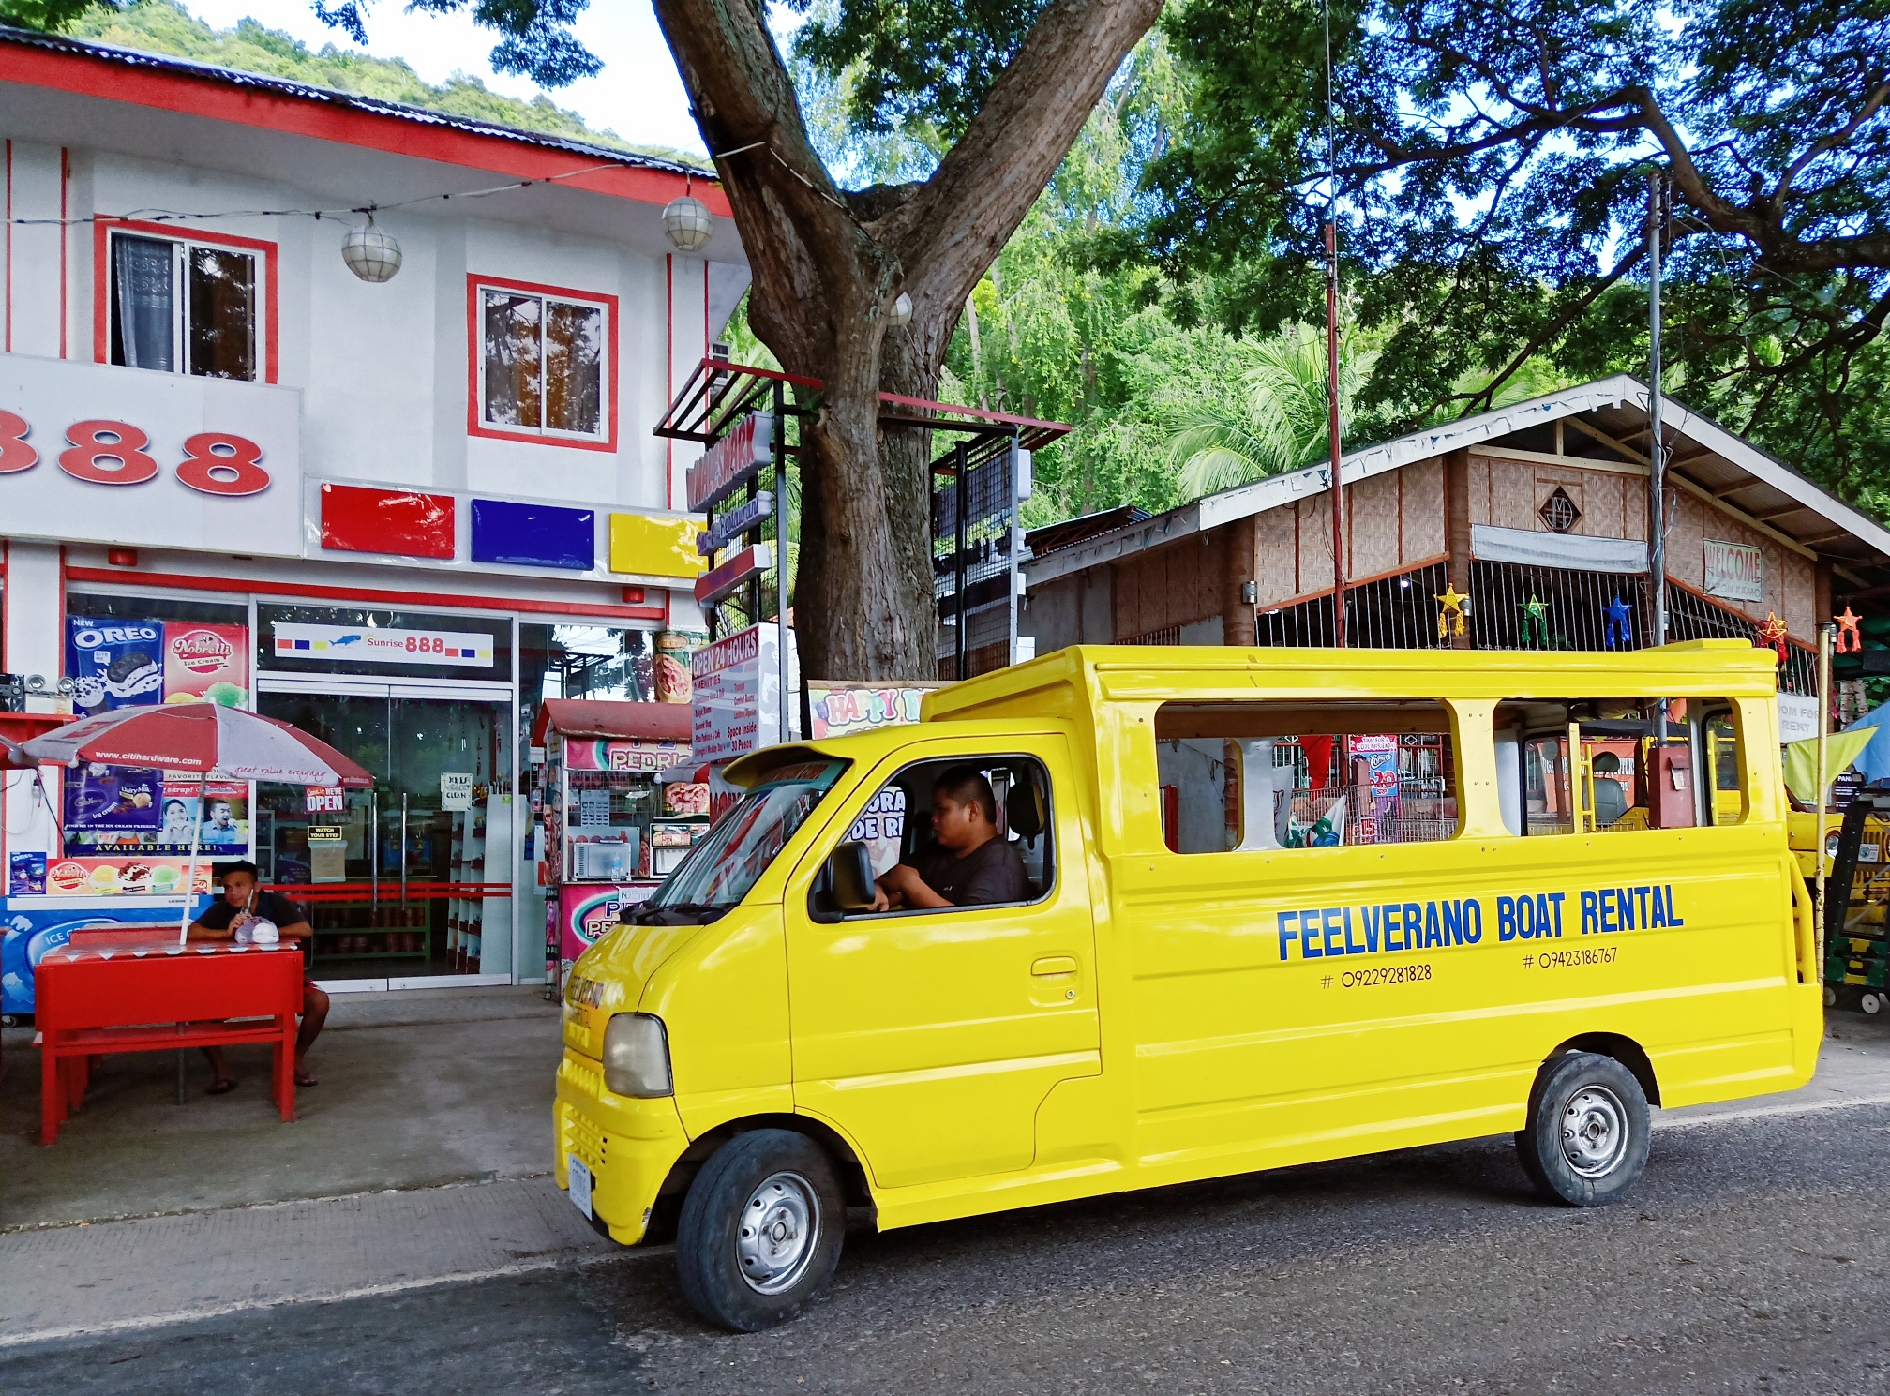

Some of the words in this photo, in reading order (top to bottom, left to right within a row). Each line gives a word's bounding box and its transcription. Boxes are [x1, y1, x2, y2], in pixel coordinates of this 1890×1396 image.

[1705, 545, 1760, 583] WELCOME
[74, 627, 157, 648] OREO
[367, 637, 404, 648] Sunrise
[405, 636, 444, 653] 888
[693, 649, 714, 678] OPEN
[715, 644, 725, 670] 24
[727, 631, 757, 665] HOURS
[826, 690, 897, 725] HAPPY
[1778, 705, 1797, 717] OM
[728, 727, 742, 740] Space
[1781, 720, 1810, 732] RENT
[95, 751, 202, 766] www.citihardware.com
[611, 751, 687, 770] PEDRI
[235, 766, 257, 774] great
[261, 766, 284, 774] value
[121, 786, 138, 794] Dairy
[138, 785, 151, 793] Milk
[307, 795, 343, 811] OPEN
[852, 818, 879, 840] DE
[95, 843, 172, 852] AVAILABLE
[177, 843, 217, 852] HERE!
[1277, 898, 1481, 960] FEELVERANO
[1497, 892, 1566, 941] BOAT
[1581, 885, 1684, 935] RENTAL
[46, 932, 65, 945] ICE
[1522, 953, 1534, 969] #
[1539, 947, 1618, 969] 09423186767
[1320, 974, 1334, 989] #
[1342, 964, 1432, 988] 09229281828
